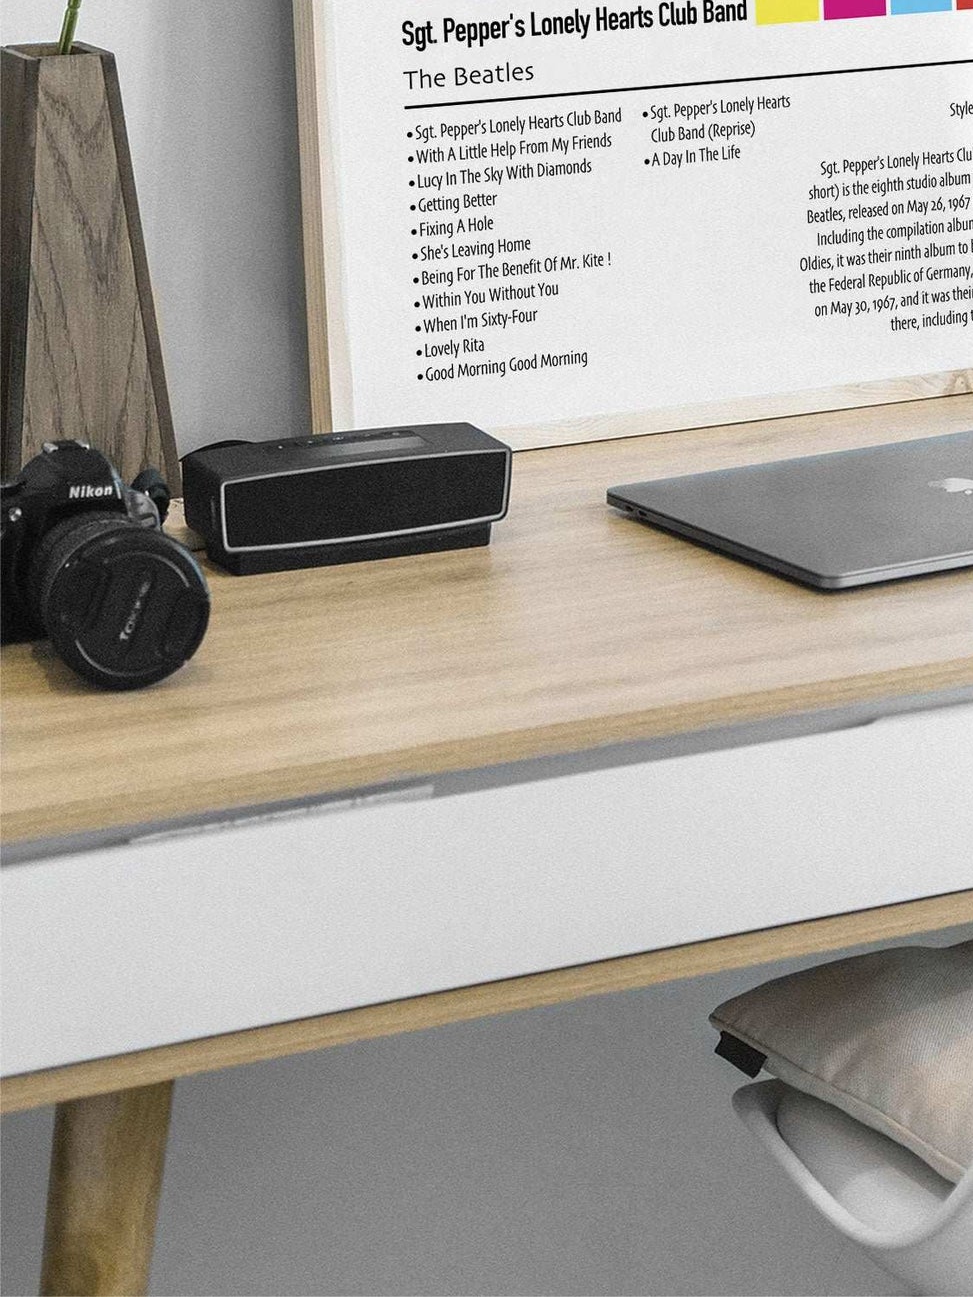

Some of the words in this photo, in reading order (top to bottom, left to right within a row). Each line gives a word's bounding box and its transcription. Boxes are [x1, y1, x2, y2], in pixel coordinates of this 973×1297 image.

[402, 20, 438, 52] Sgt.
[443, 13, 525, 48] Pepper's
[531, 8, 591, 39] Lonely
[596, 5, 653, 31] Hearts
[659, 0, 697, 27] Club
[403, 69, 446, 90] The
[454, 62, 534, 86] Beatles
[651, 105, 671, 123] Sgt.
[674, 100, 717, 121] Pepper's
[721, 96, 754, 115] Lonely
[757, 95, 790, 110] Hearts
[415, 125, 437, 143] Sgt.
[441, 119, 487, 141] Pepper's
[490, 116, 525, 135] Lonely
[529, 115, 564, 130] Hearts
[567, 110, 591, 126] Club
[594, 107, 621, 124] Band
[651, 127, 675, 143] Club
[678, 123, 705, 140] Band
[708, 120, 755, 141] (Reprise)
[416, 147, 444, 164] With
[447, 147, 456, 161] A
[459, 143, 487, 160] Little
[491, 141, 516, 160] Help
[520, 140, 548, 155] From
[552, 137, 569, 155] My
[572, 132, 612, 150] Friends
[652, 152, 660, 167] A
[663, 152, 683, 168] Day
[686, 150, 696, 163] In
[698, 147, 719, 162] The
[722, 144, 740, 160] Life
[417, 174, 443, 191] Lucy
[446, 172, 457, 186] In
[459, 168, 481, 184] The
[484, 166, 503, 185] Sky
[506, 163, 534, 180] With
[537, 158, 592, 177] Diamonds
[821, 161, 840, 179] Sgt.
[843, 155, 885, 176] Pepper's
[887, 152, 919, 170] Lonely
[923, 151, 954, 165] Hearts
[809, 184, 839, 201] short)
[842, 183, 850, 196] is
[852, 180, 869, 195] the
[871, 177, 904, 197] eighth
[906, 174, 937, 190] studio
[939, 172, 971, 187] album
[418, 196, 459, 214] Getting
[463, 194, 498, 208] Better
[807, 207, 846, 224] Beatles,
[849, 201, 888, 219] released
[891, 203, 904, 215] on
[907, 200, 928, 215] May
[931, 197, 946, 212] 26,
[948, 194, 970, 212] 1967
[420, 221, 453, 238] Fixing
[457, 219, 466, 233] A
[468, 215, 494, 232] Hole
[421, 244, 449, 261] She's
[452, 241, 494, 258] Leaving
[498, 239, 531, 253] Home
[800, 255, 834, 271] Oldies,
[837, 254, 844, 267] it
[846, 254, 866, 266] was
[868, 249, 892, 264] their
[895, 245, 921, 261] ninth
[924, 243, 955, 258] album
[958, 242, 968, 254] to
[422, 271, 453, 287] Being
[457, 267, 476, 282] For
[478, 263, 499, 279] The
[502, 258, 542, 277] Benefit
[544, 256, 558, 272] Of
[560, 256, 579, 271] Mr.
[583, 253, 604, 268] Kite
[608, 252, 611, 266] !
[422, 292, 461, 309] Within
[464, 290, 485, 304] You
[489, 285, 536, 302] Without
[538, 283, 558, 297] You
[815, 305, 827, 317] on
[831, 301, 853, 317] May
[855, 301, 870, 315] 30,
[872, 295, 898, 313] 1967,
[901, 291, 919, 307] and
[921, 291, 929, 304] it
[931, 291, 950, 303] was
[423, 317, 457, 333] When
[461, 314, 478, 329] I'm
[482, 309, 538, 329] Sixty-Four
[890, 316, 919, 331] there,
[922, 310, 968, 327] including
[425, 339, 460, 358] Lovely
[463, 338, 484, 353] Rita
[426, 363, 454, 381] Good
[458, 360, 506, 378] Morning
[509, 354, 537, 371] Good
[541, 350, 587, 368] Morning
[69, 485, 113, 499] Nikon
